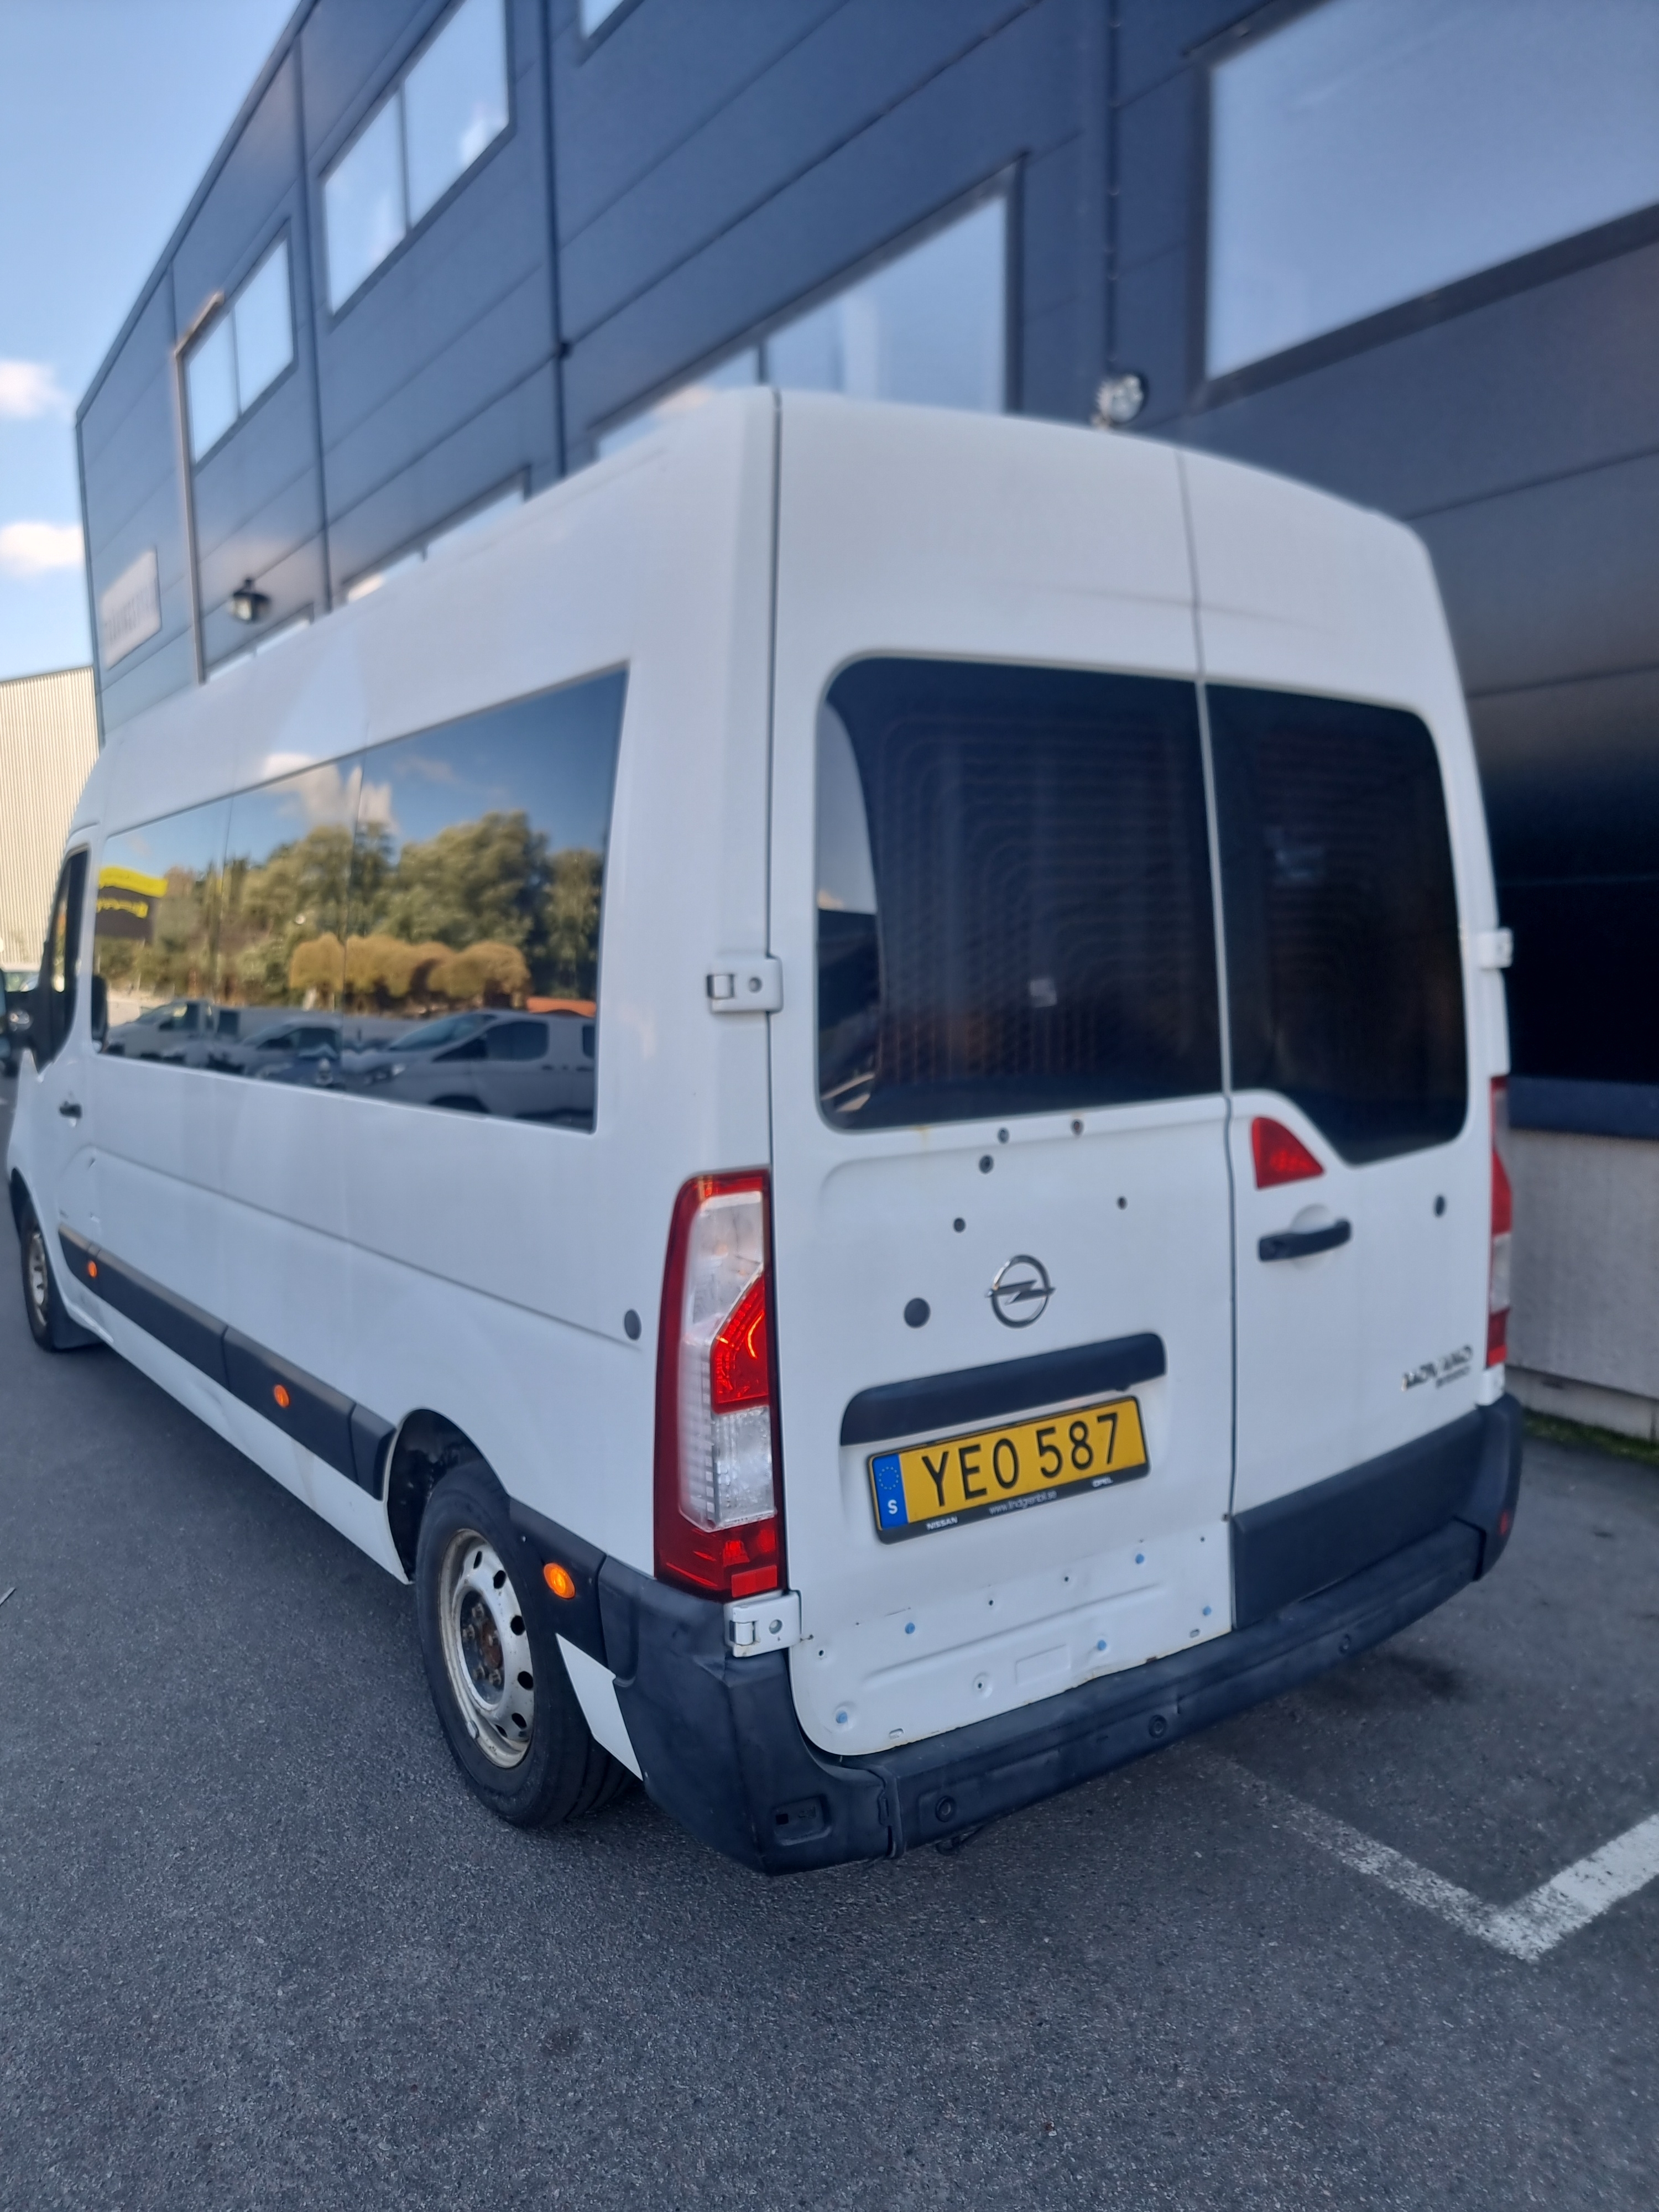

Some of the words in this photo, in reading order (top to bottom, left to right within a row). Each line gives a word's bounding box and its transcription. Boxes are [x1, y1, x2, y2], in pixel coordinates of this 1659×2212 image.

[922, 1438, 1019, 1507] YEO
[1036, 1412, 1118, 1478] 587
[888, 1499, 898, 1515] S
[926, 1515, 958, 1531] NISSAN
